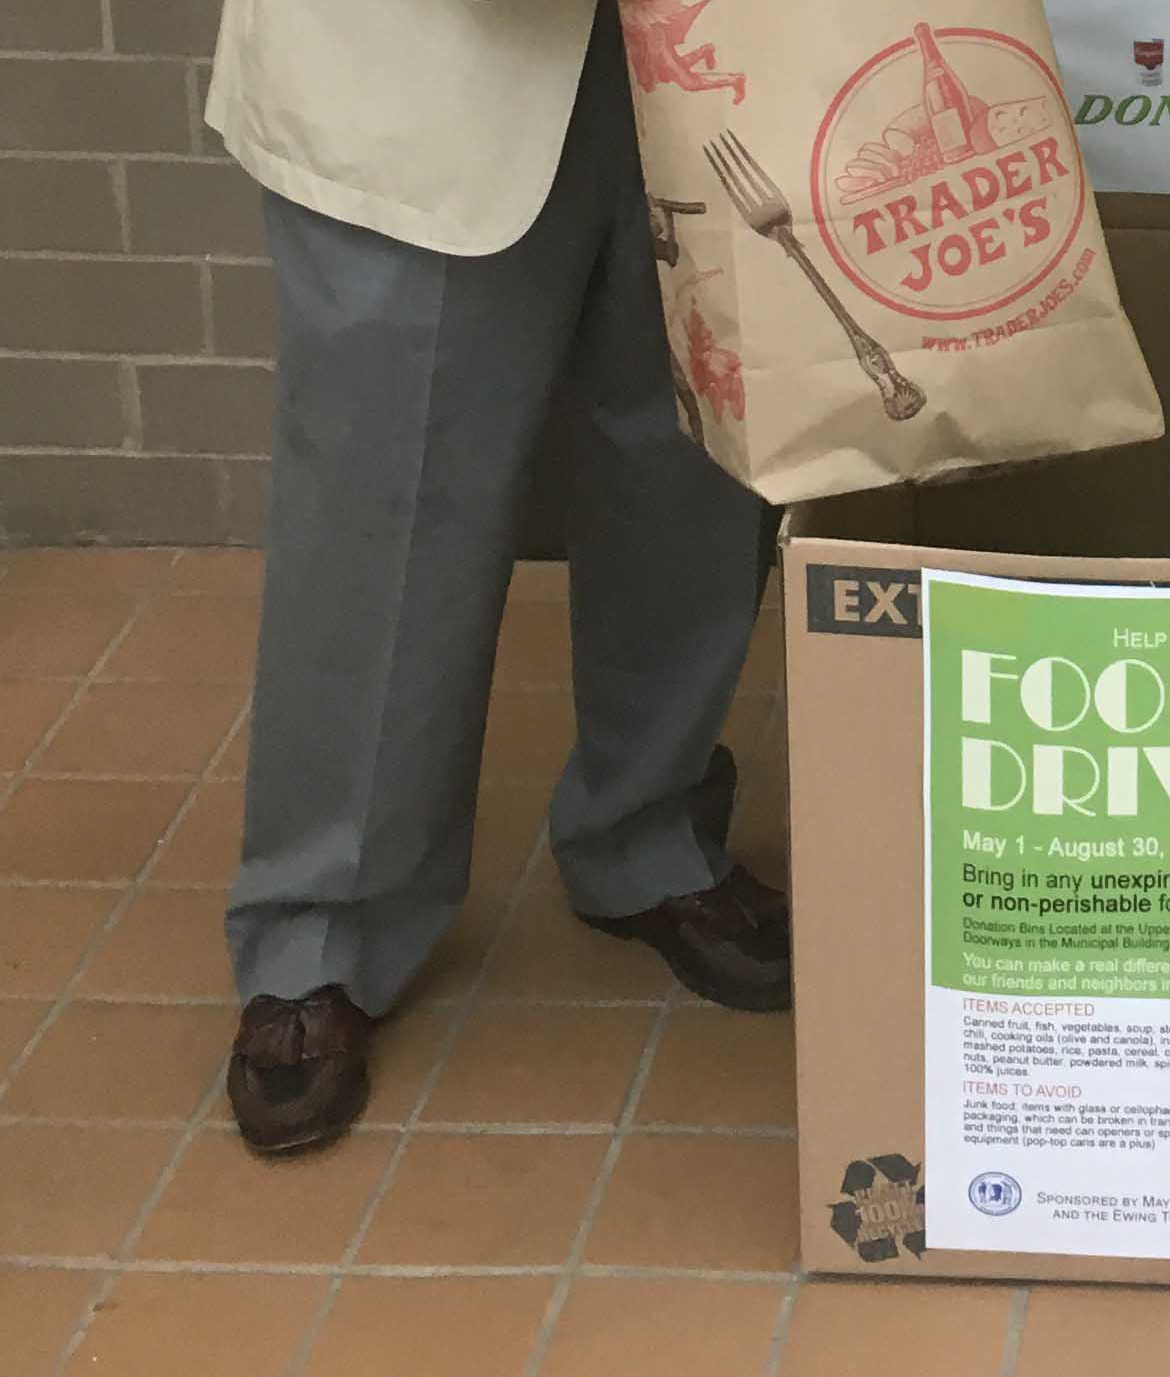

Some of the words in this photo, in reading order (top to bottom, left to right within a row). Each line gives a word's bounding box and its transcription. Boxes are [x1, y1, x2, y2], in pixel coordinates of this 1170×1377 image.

[853, 137, 1069, 255] TRADER
[901, 198, 1051, 291] JOE'S
[834, 580, 922, 625] EXT
[1113, 628, 1167, 648] HELP
[963, 830, 1006, 858] May
[1015, 836, 1025, 855] 1
[1048, 837, 1124, 861] August
[1132, 837, 1164, 859] 30,
[962, 864, 1014, 888] Bring
[1022, 869, 1038, 888] in
[1046, 872, 1083, 891] any
[962, 894, 983, 908] or
[991, 894, 1151, 916] non-perishable
[963, 918, 1015, 932] Donation
[1020, 922, 1045, 934] Bins
[1050, 923, 1096, 935] Located
[1101, 924, 1113, 935] at
[1116, 923, 1134, 935] the
[963, 932, 1021, 948] Doorways
[1025, 938, 1036, 947] in
[1039, 936, 1057, 948] the
[1062, 937, 1119, 950] Municipal
[1123, 937, 1170, 951] Building
[962, 953, 991, 969] You
[996, 958, 1023, 971] can
[1028, 958, 1070, 973] make
[1075, 962, 1085, 973] a
[1089, 960, 1118, 974] real
[962, 974, 987, 986] our
[992, 974, 1043, 990] friends
[1048, 976, 1076, 990] and
[1081, 977, 1156, 994] neighbors
[963, 999, 1008, 1012] ITEMS
[1012, 1004, 1095, 1016] ACCEPTED
[963, 1017, 1004, 1029] Canned
[991, 1031, 1033, 1044] cooking
[1037, 1033, 1054, 1042] oils
[1057, 1034, 1085, 1045] (olive
[1090, 1034, 1110, 1044] and
[963, 1082, 1008, 1095] ITEMS
[1014, 1084, 1032, 1096] TO
[1036, 1085, 1082, 1098] AVOID
[1025, 1113, 1055, 1123] which
[1058, 1115, 1077, 1124] can
[1081, 1115, 1094, 1124] be
[1098, 1115, 1134, 1125] broken
[1037, 1192, 1118, 1207] SPONSORED
[1123, 1196, 1138, 1207] BY
[1053, 1210, 1080, 1221] AND
[1085, 1211, 1108, 1221] THE
[1113, 1210, 1157, 1223] EWING
